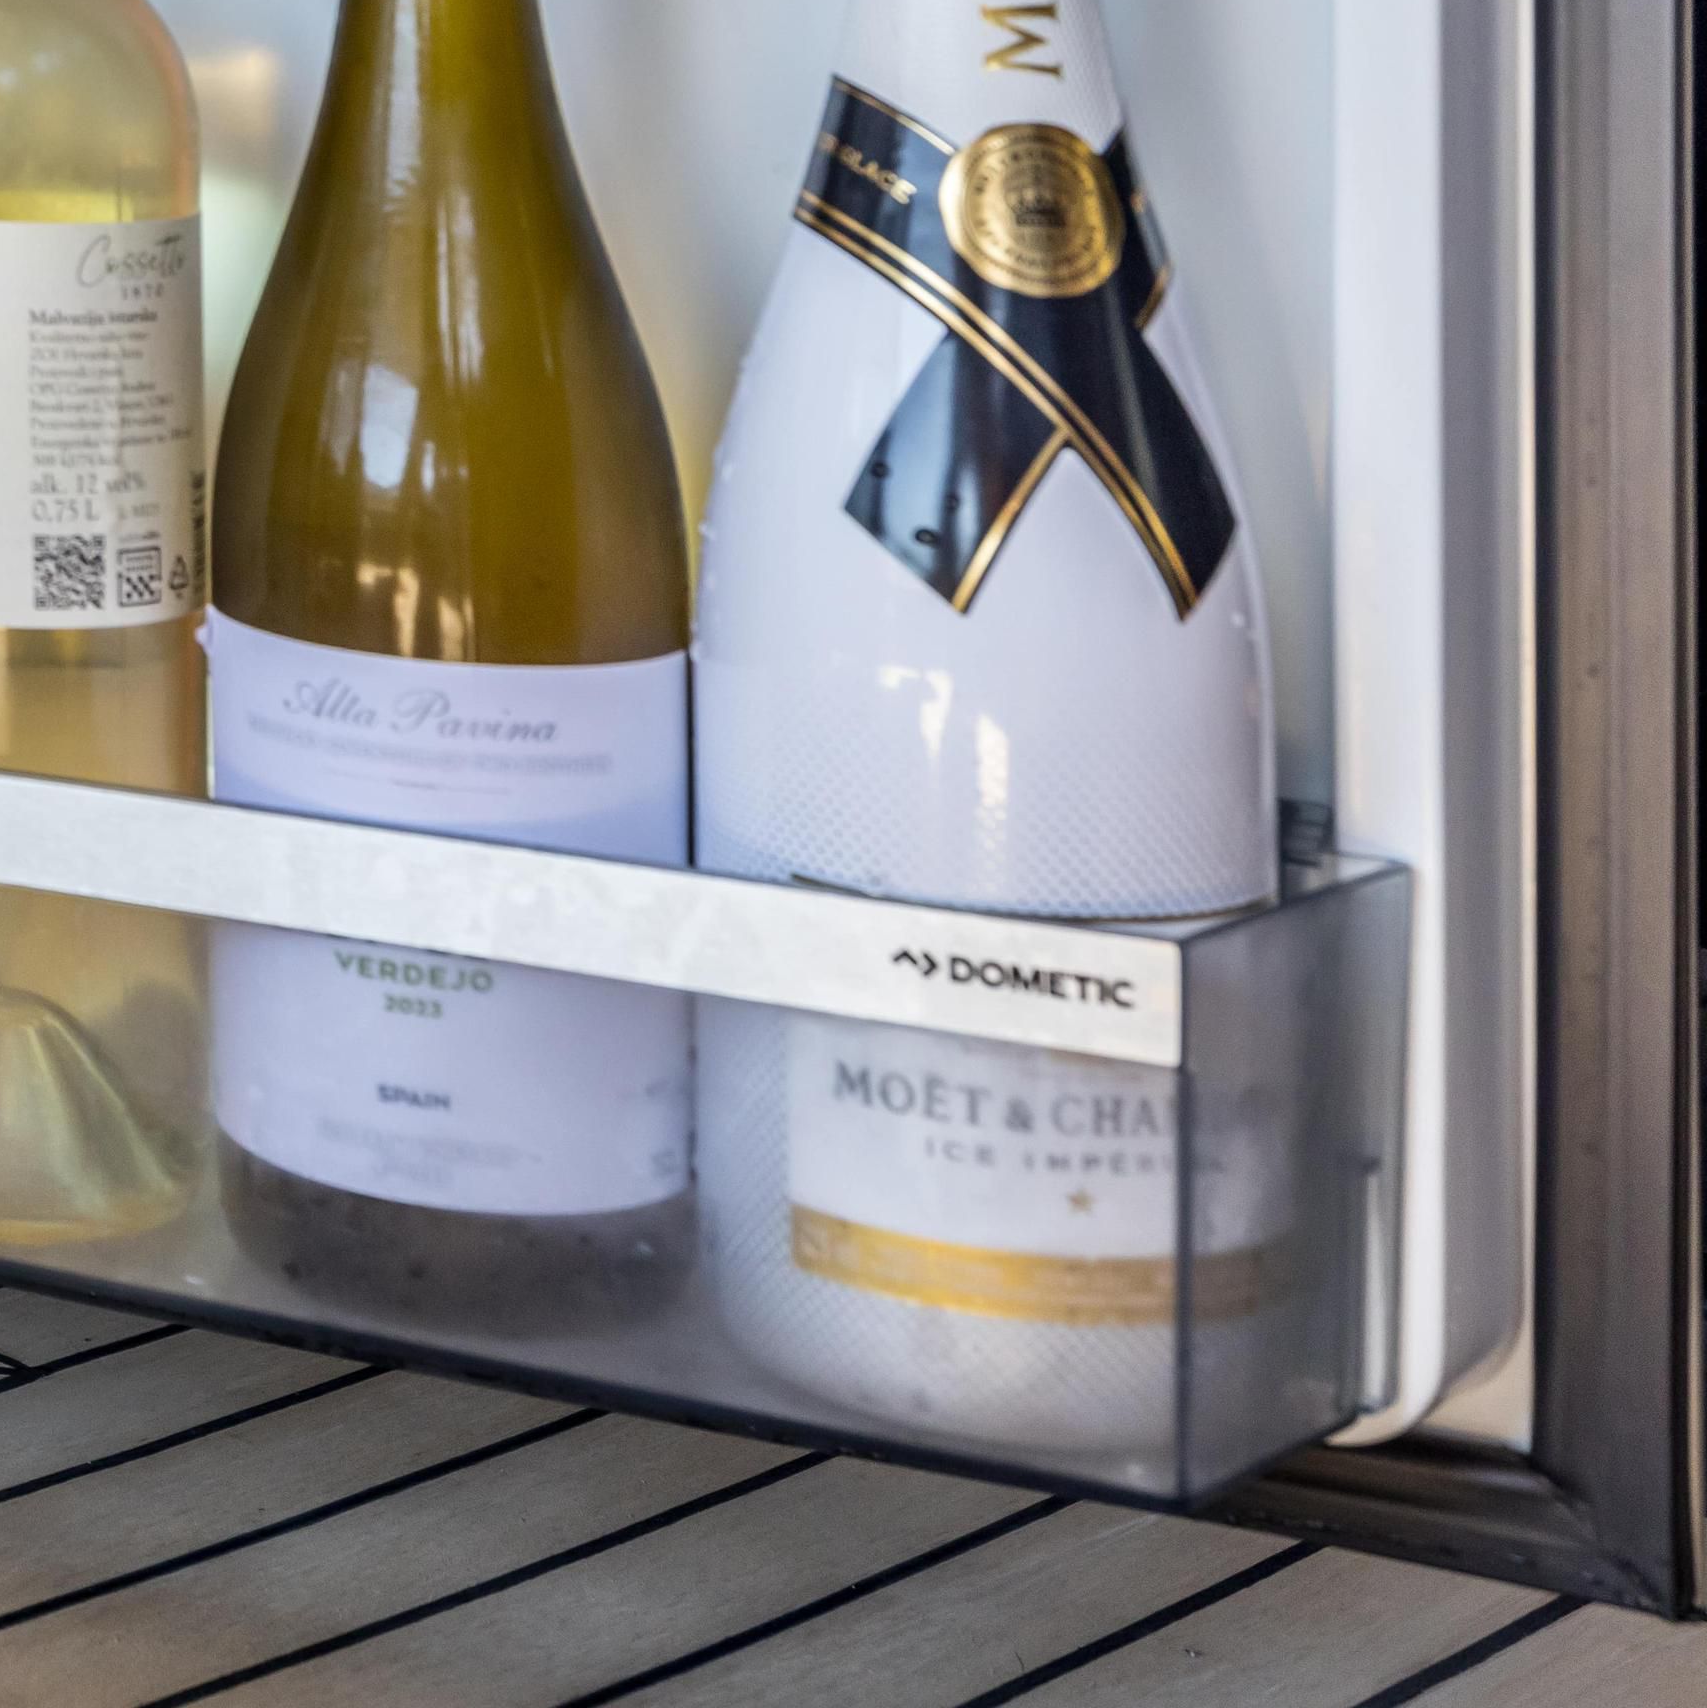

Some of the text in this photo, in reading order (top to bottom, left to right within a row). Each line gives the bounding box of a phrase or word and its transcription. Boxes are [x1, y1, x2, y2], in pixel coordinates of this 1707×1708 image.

[283, 676, 378, 729] Alta
[390, 687, 559, 744] Pavina
[333, 949, 495, 994] VERDEJO
[950, 956, 1138, 1010] DOMETIC
[377, 1083, 452, 1112] SPAIN
[833, 1059, 992, 1127] MOËT
[1002, 1096, 1034, 1132] &
[926, 1138, 996, 1169] ICE
